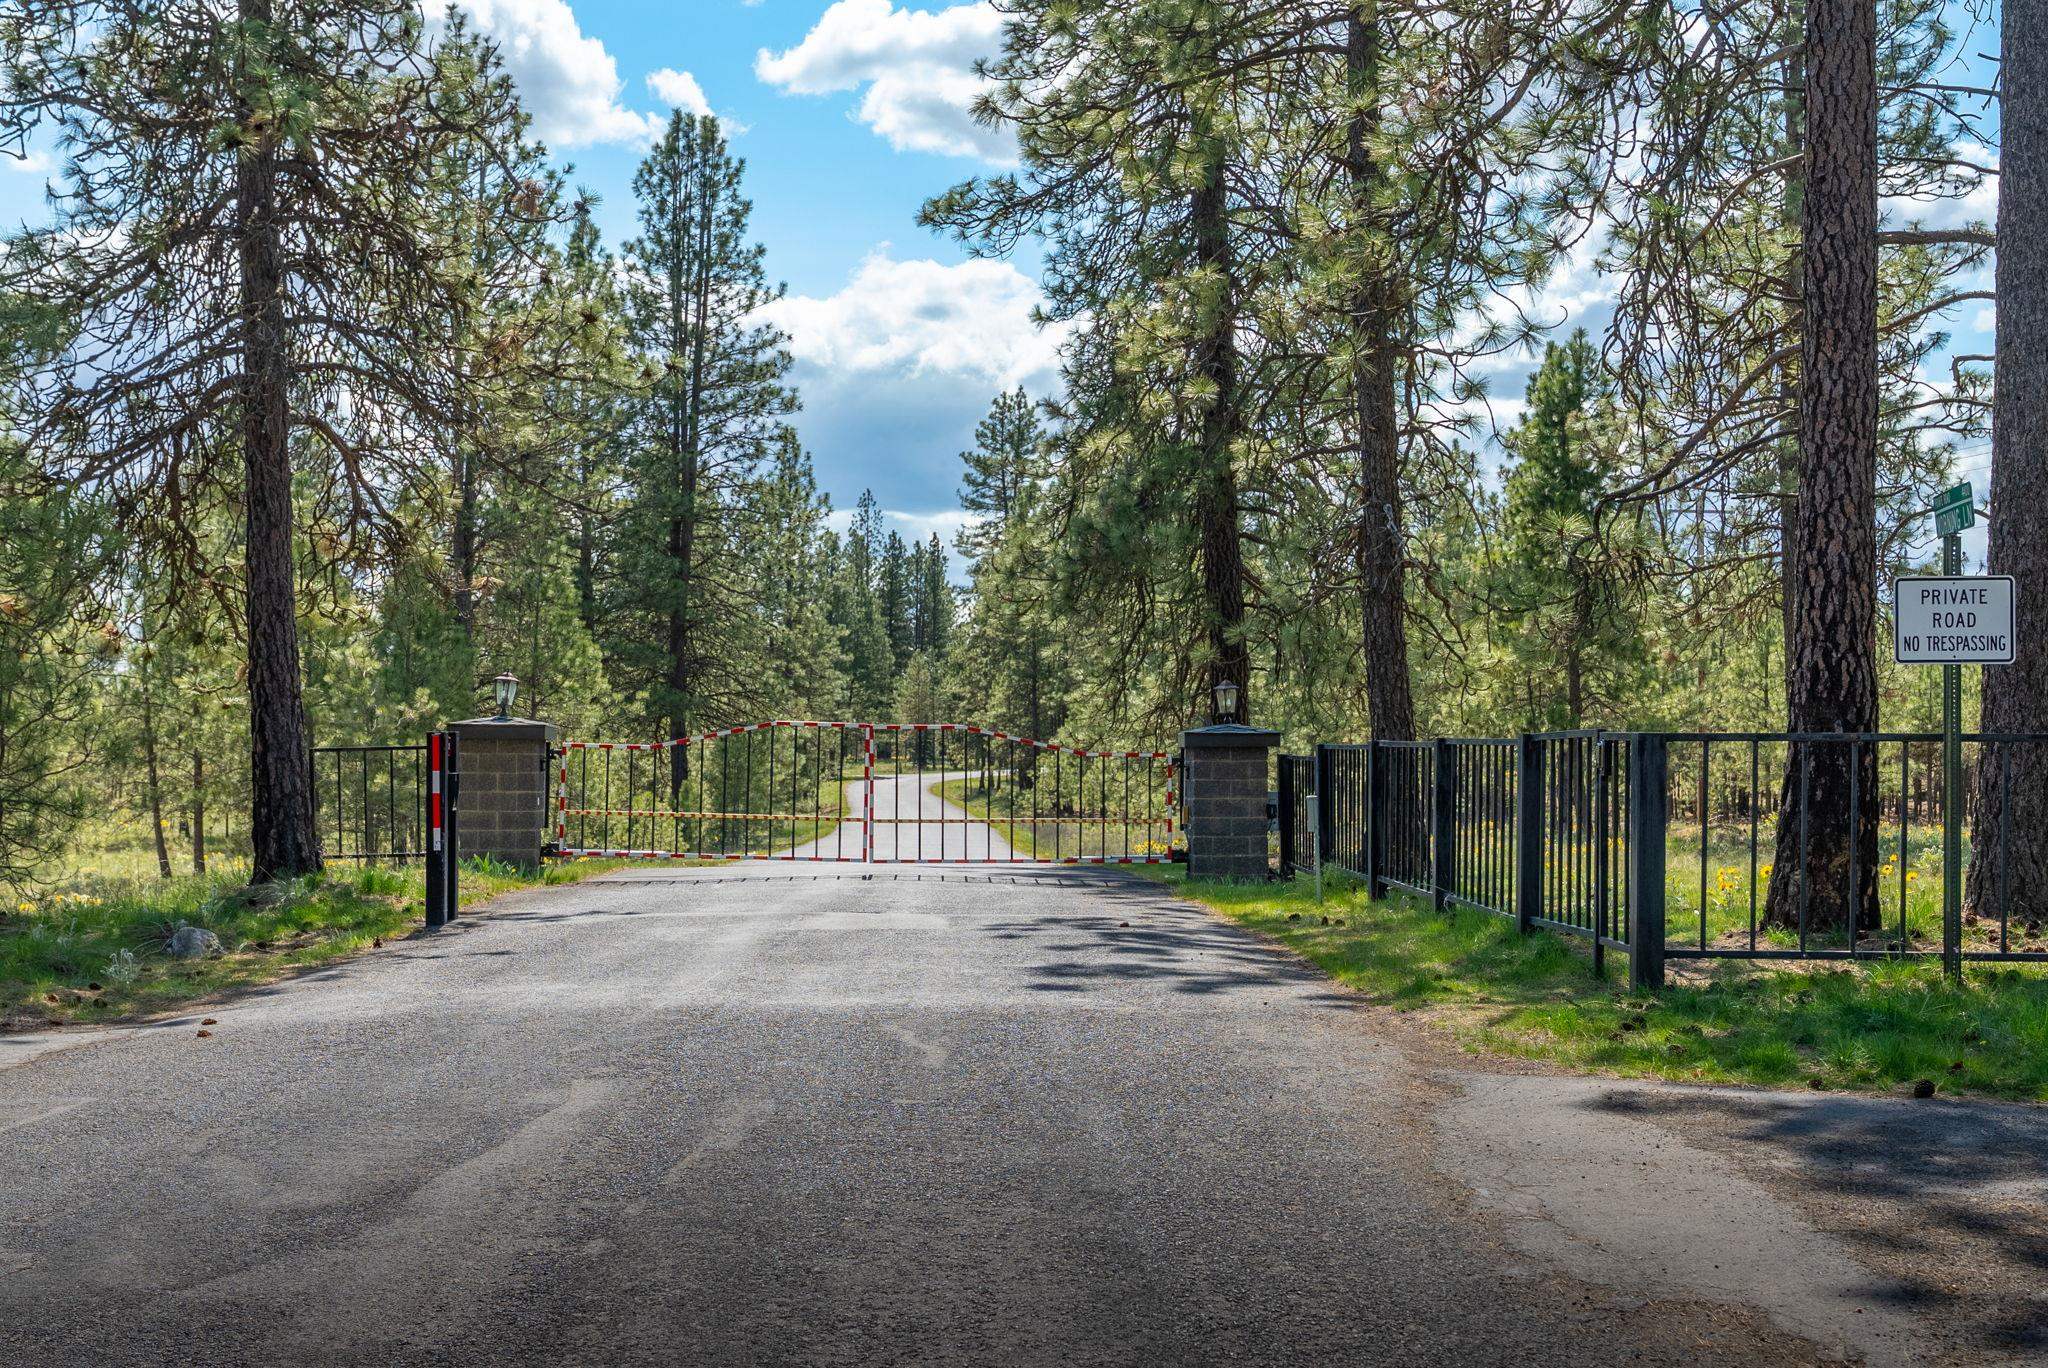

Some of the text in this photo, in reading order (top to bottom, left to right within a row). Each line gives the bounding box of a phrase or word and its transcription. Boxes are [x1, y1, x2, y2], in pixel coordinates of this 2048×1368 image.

[1962, 502, 1973, 526] LN
[1921, 588, 1988, 605] PRIVATE
[1932, 612, 1977, 628] ROAD
[1903, 634, 2006, 652] NO TRESPASSING
